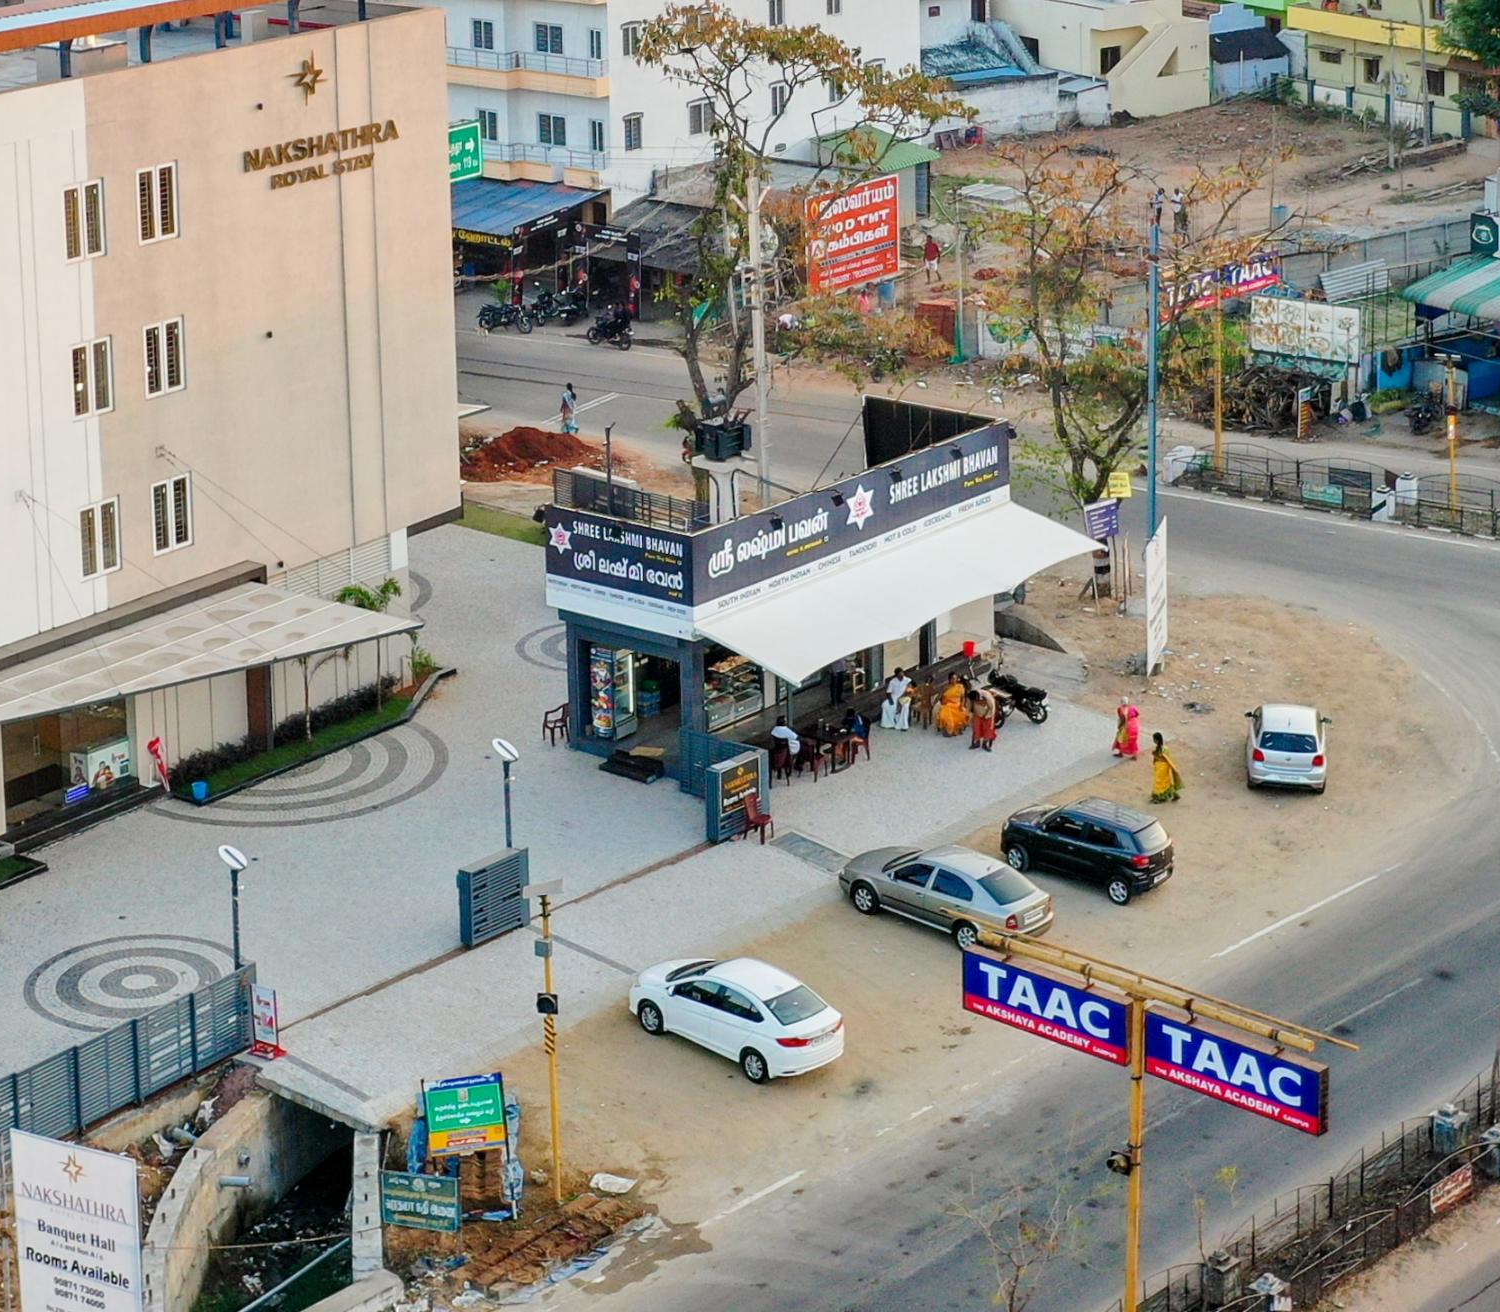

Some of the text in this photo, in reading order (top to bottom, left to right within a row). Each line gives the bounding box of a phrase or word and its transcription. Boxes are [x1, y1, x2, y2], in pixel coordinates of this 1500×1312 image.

[243, 119, 400, 173] NAKSHATHRA
[271, 153, 375, 190] ROYAL STAY
[857, 209, 890, 227] TMT
[890, 445, 998, 505] SHREE LAKSHMI BHAVAN
[572, 520, 684, 559] SHREE LSHMI BHAVAN
[787, 507, 829, 543] பவன்
[979, 961, 1111, 1040] TAAC
[986, 1004, 1036, 1031] AKSHAYA
[1037, 1023, 1090, 1049] ACADEMY
[1161, 1023, 1302, 1108] TAAC
[1168, 1069, 1223, 1097] AKSHAYA
[1224, 1089, 1281, 1117] ACADEMY
[20, 1181, 127, 1225] NAKSHATHRA
[37, 1218, 116, 1253] Banquet Hall
[26, 1246, 130, 1289] Rooms Available
[79, 1285, 105, 1299] 73000
